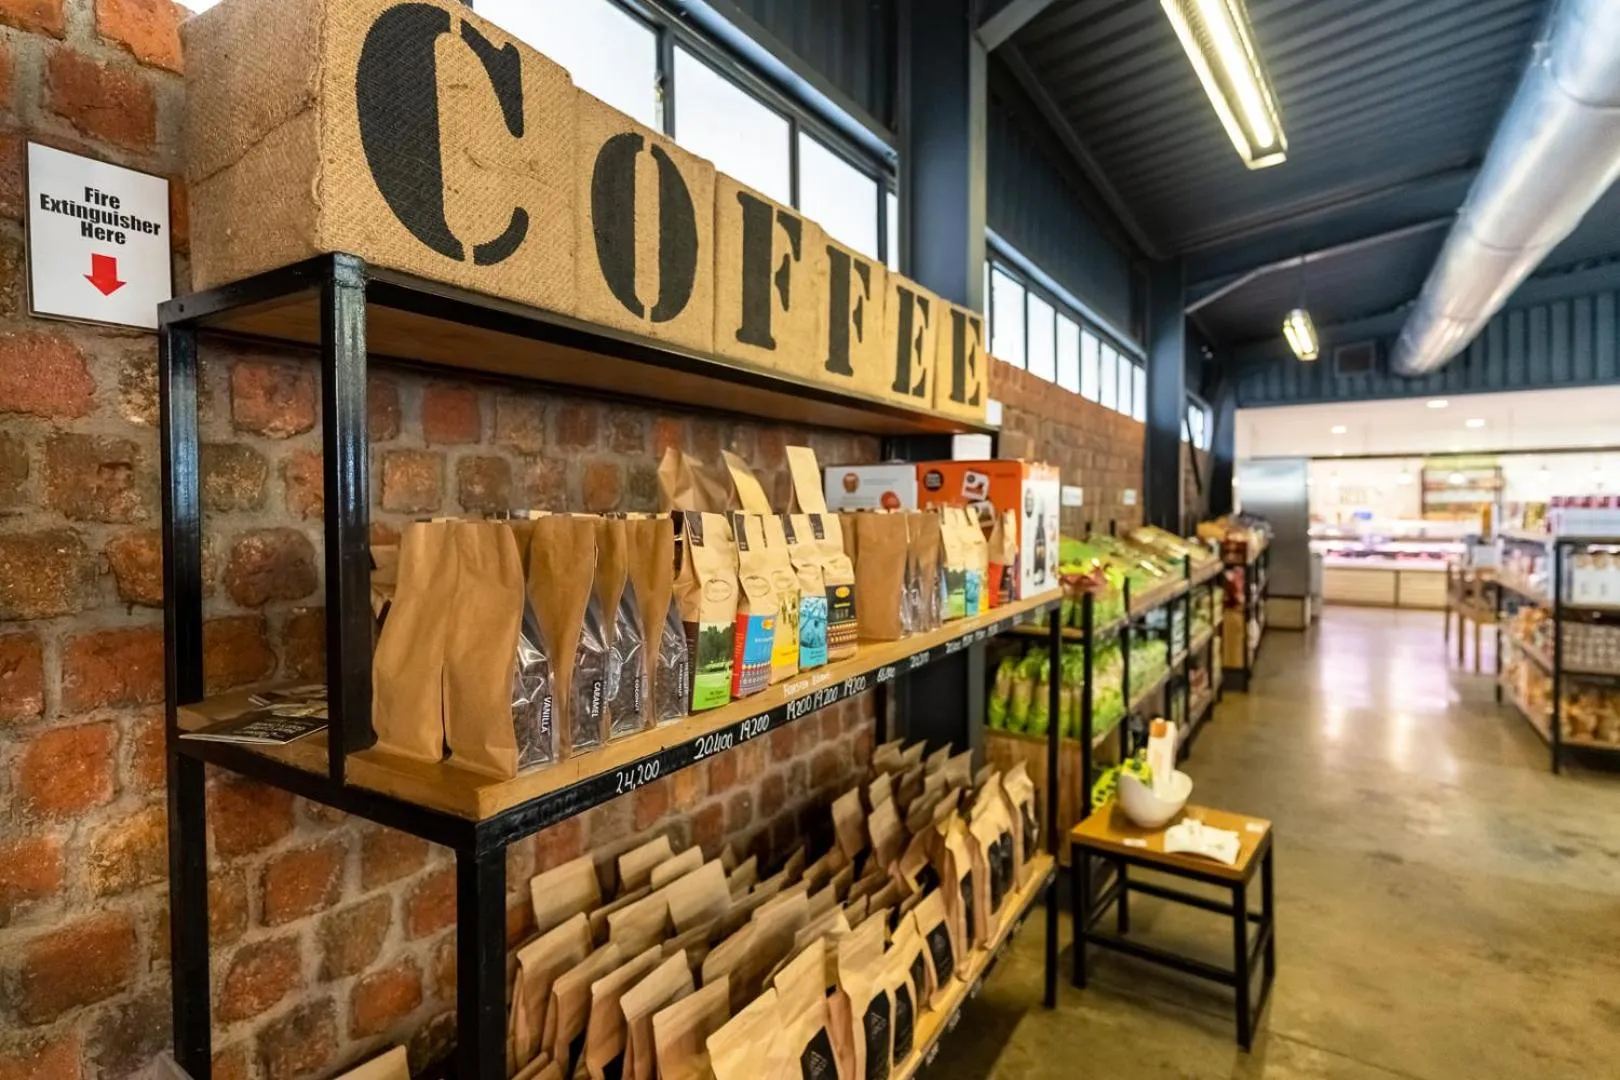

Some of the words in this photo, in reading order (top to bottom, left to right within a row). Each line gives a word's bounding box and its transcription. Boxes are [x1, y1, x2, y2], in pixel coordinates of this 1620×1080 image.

[39, 193, 161, 236] Extinguisher
[84, 186, 121, 209] Fire
[355, 2, 982, 407] COFFEE
[80, 220, 126, 245] Here
[541, 696, 552, 735] VANILLA
[591, 681, 602, 718] CARAMEL
[740, 713, 770, 742] 19200
